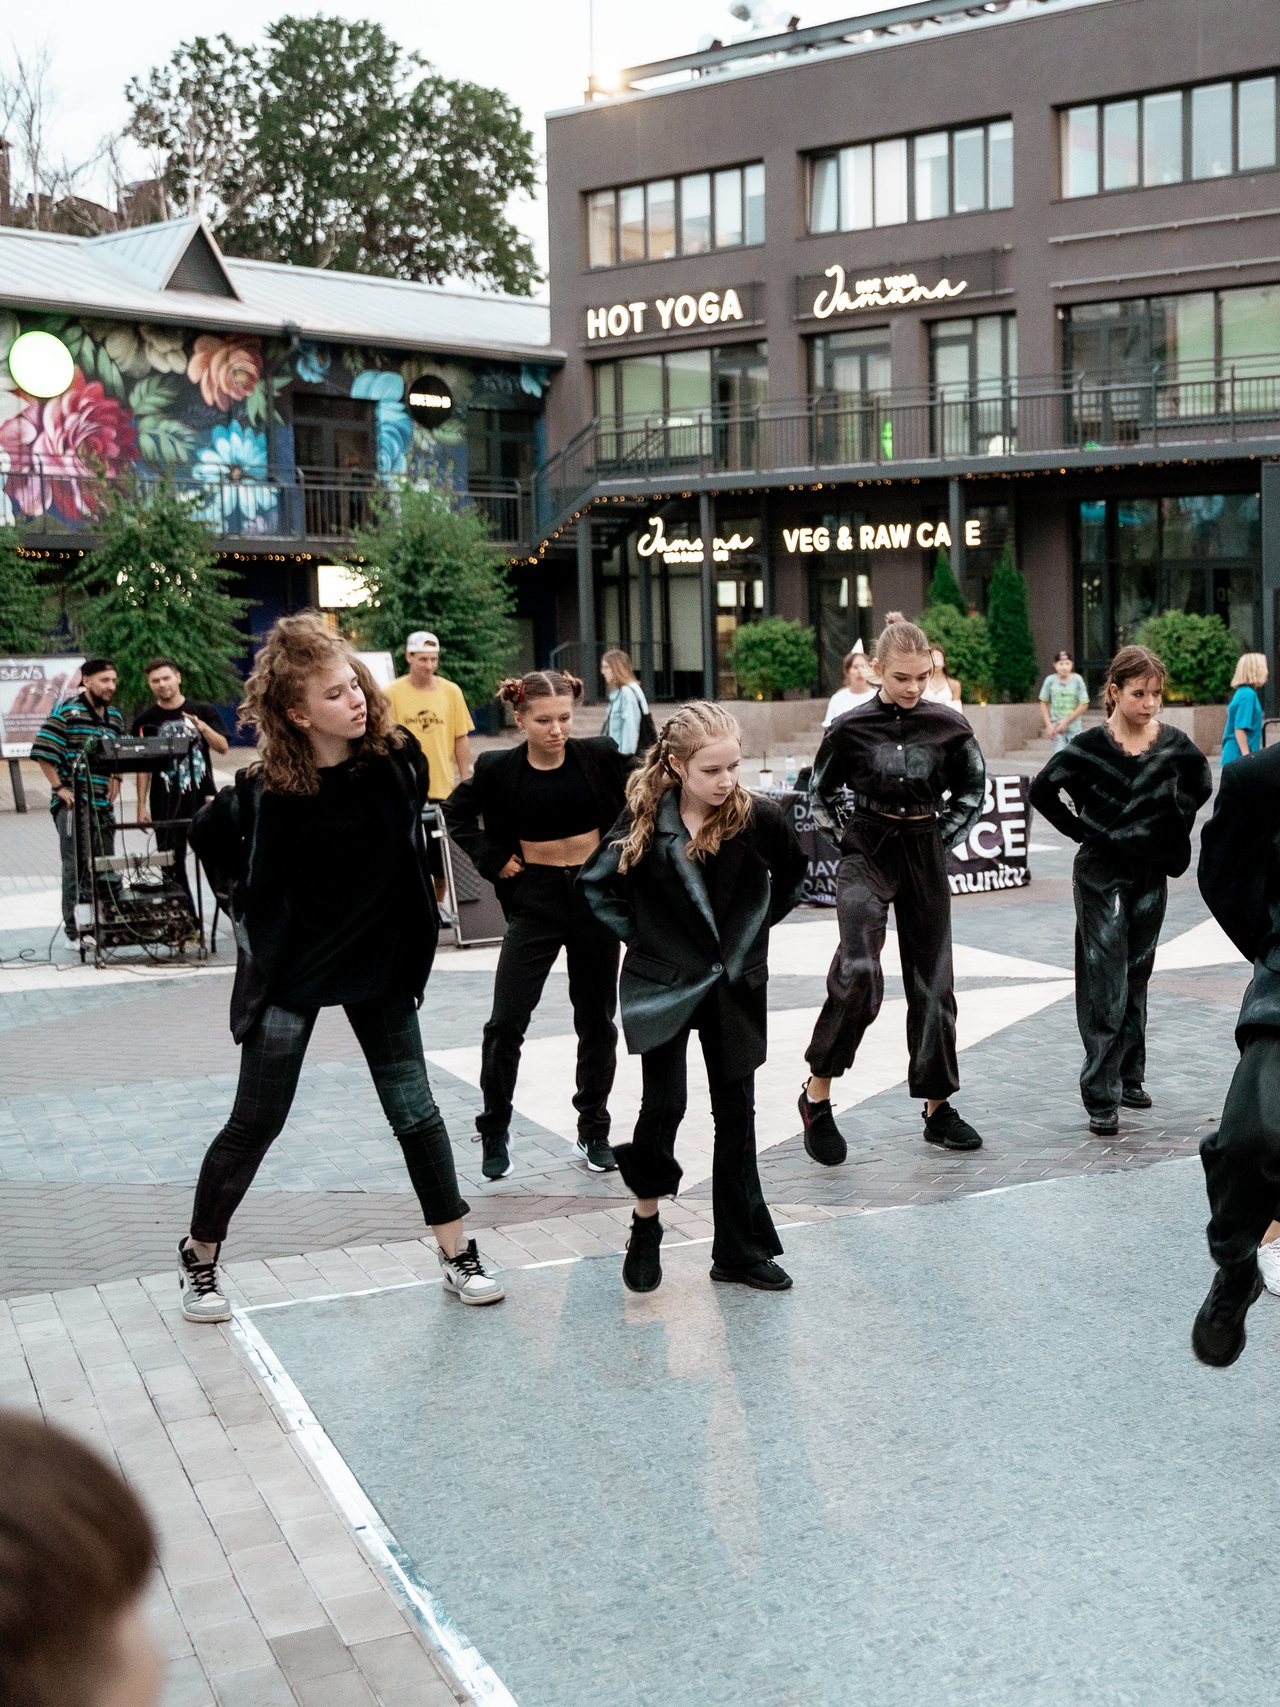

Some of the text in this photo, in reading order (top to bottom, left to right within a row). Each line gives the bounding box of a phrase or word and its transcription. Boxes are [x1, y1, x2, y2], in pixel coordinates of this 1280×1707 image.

[587, 289, 742, 339] HOT YOGA
[783, 520, 981, 553] VEG & RAW CAE
